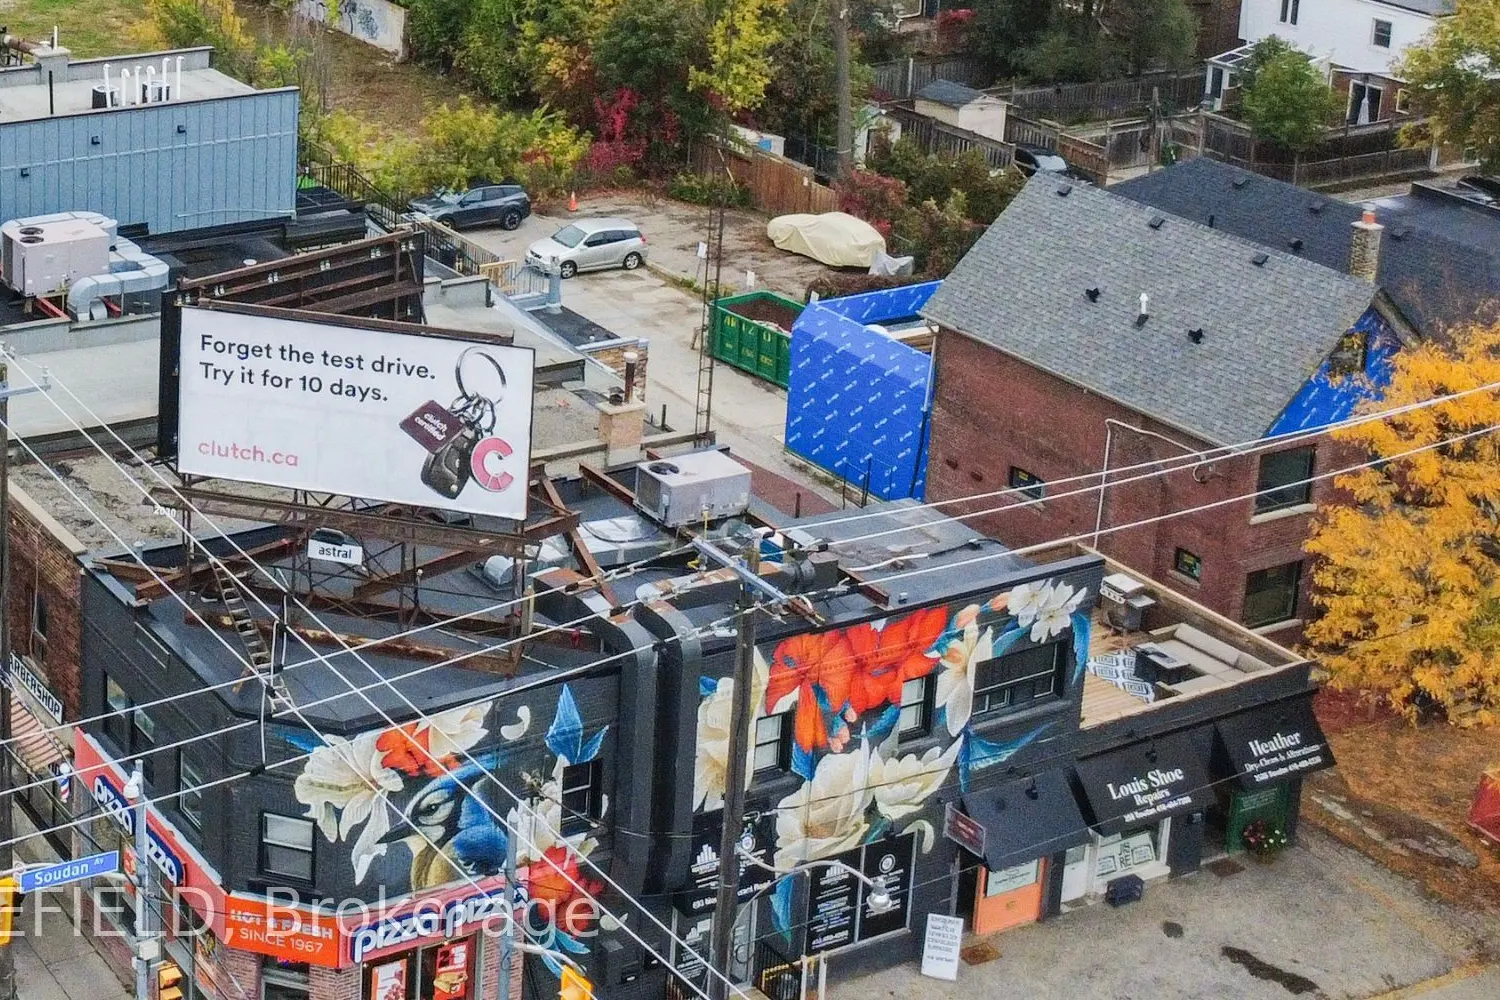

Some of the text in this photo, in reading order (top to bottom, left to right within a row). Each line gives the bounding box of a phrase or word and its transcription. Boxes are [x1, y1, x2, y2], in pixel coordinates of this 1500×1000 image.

[200, 335, 436, 379] Forget the test drive.
[199, 362, 388, 402] Try it for 10 days.
[424, 413, 448, 432] clutch
[198, 440, 299, 467] clutch.ca
[318, 546, 352, 559] astral
[9, 655, 61, 717] ARBERSHOP
[1249, 731, 1301, 757] Heather
[1107, 767, 1184, 800] Louis Shoe
[1134, 788, 1170, 807] Repairs
[34, 857, 105, 885] Soudan Av
[146, 832, 178, 886] zza
[230, 909, 263, 926] HOT
[282, 919, 333, 939] FRESH
[354, 911, 440, 964] pizza
[240, 927, 324, 953] SINCE 1967
